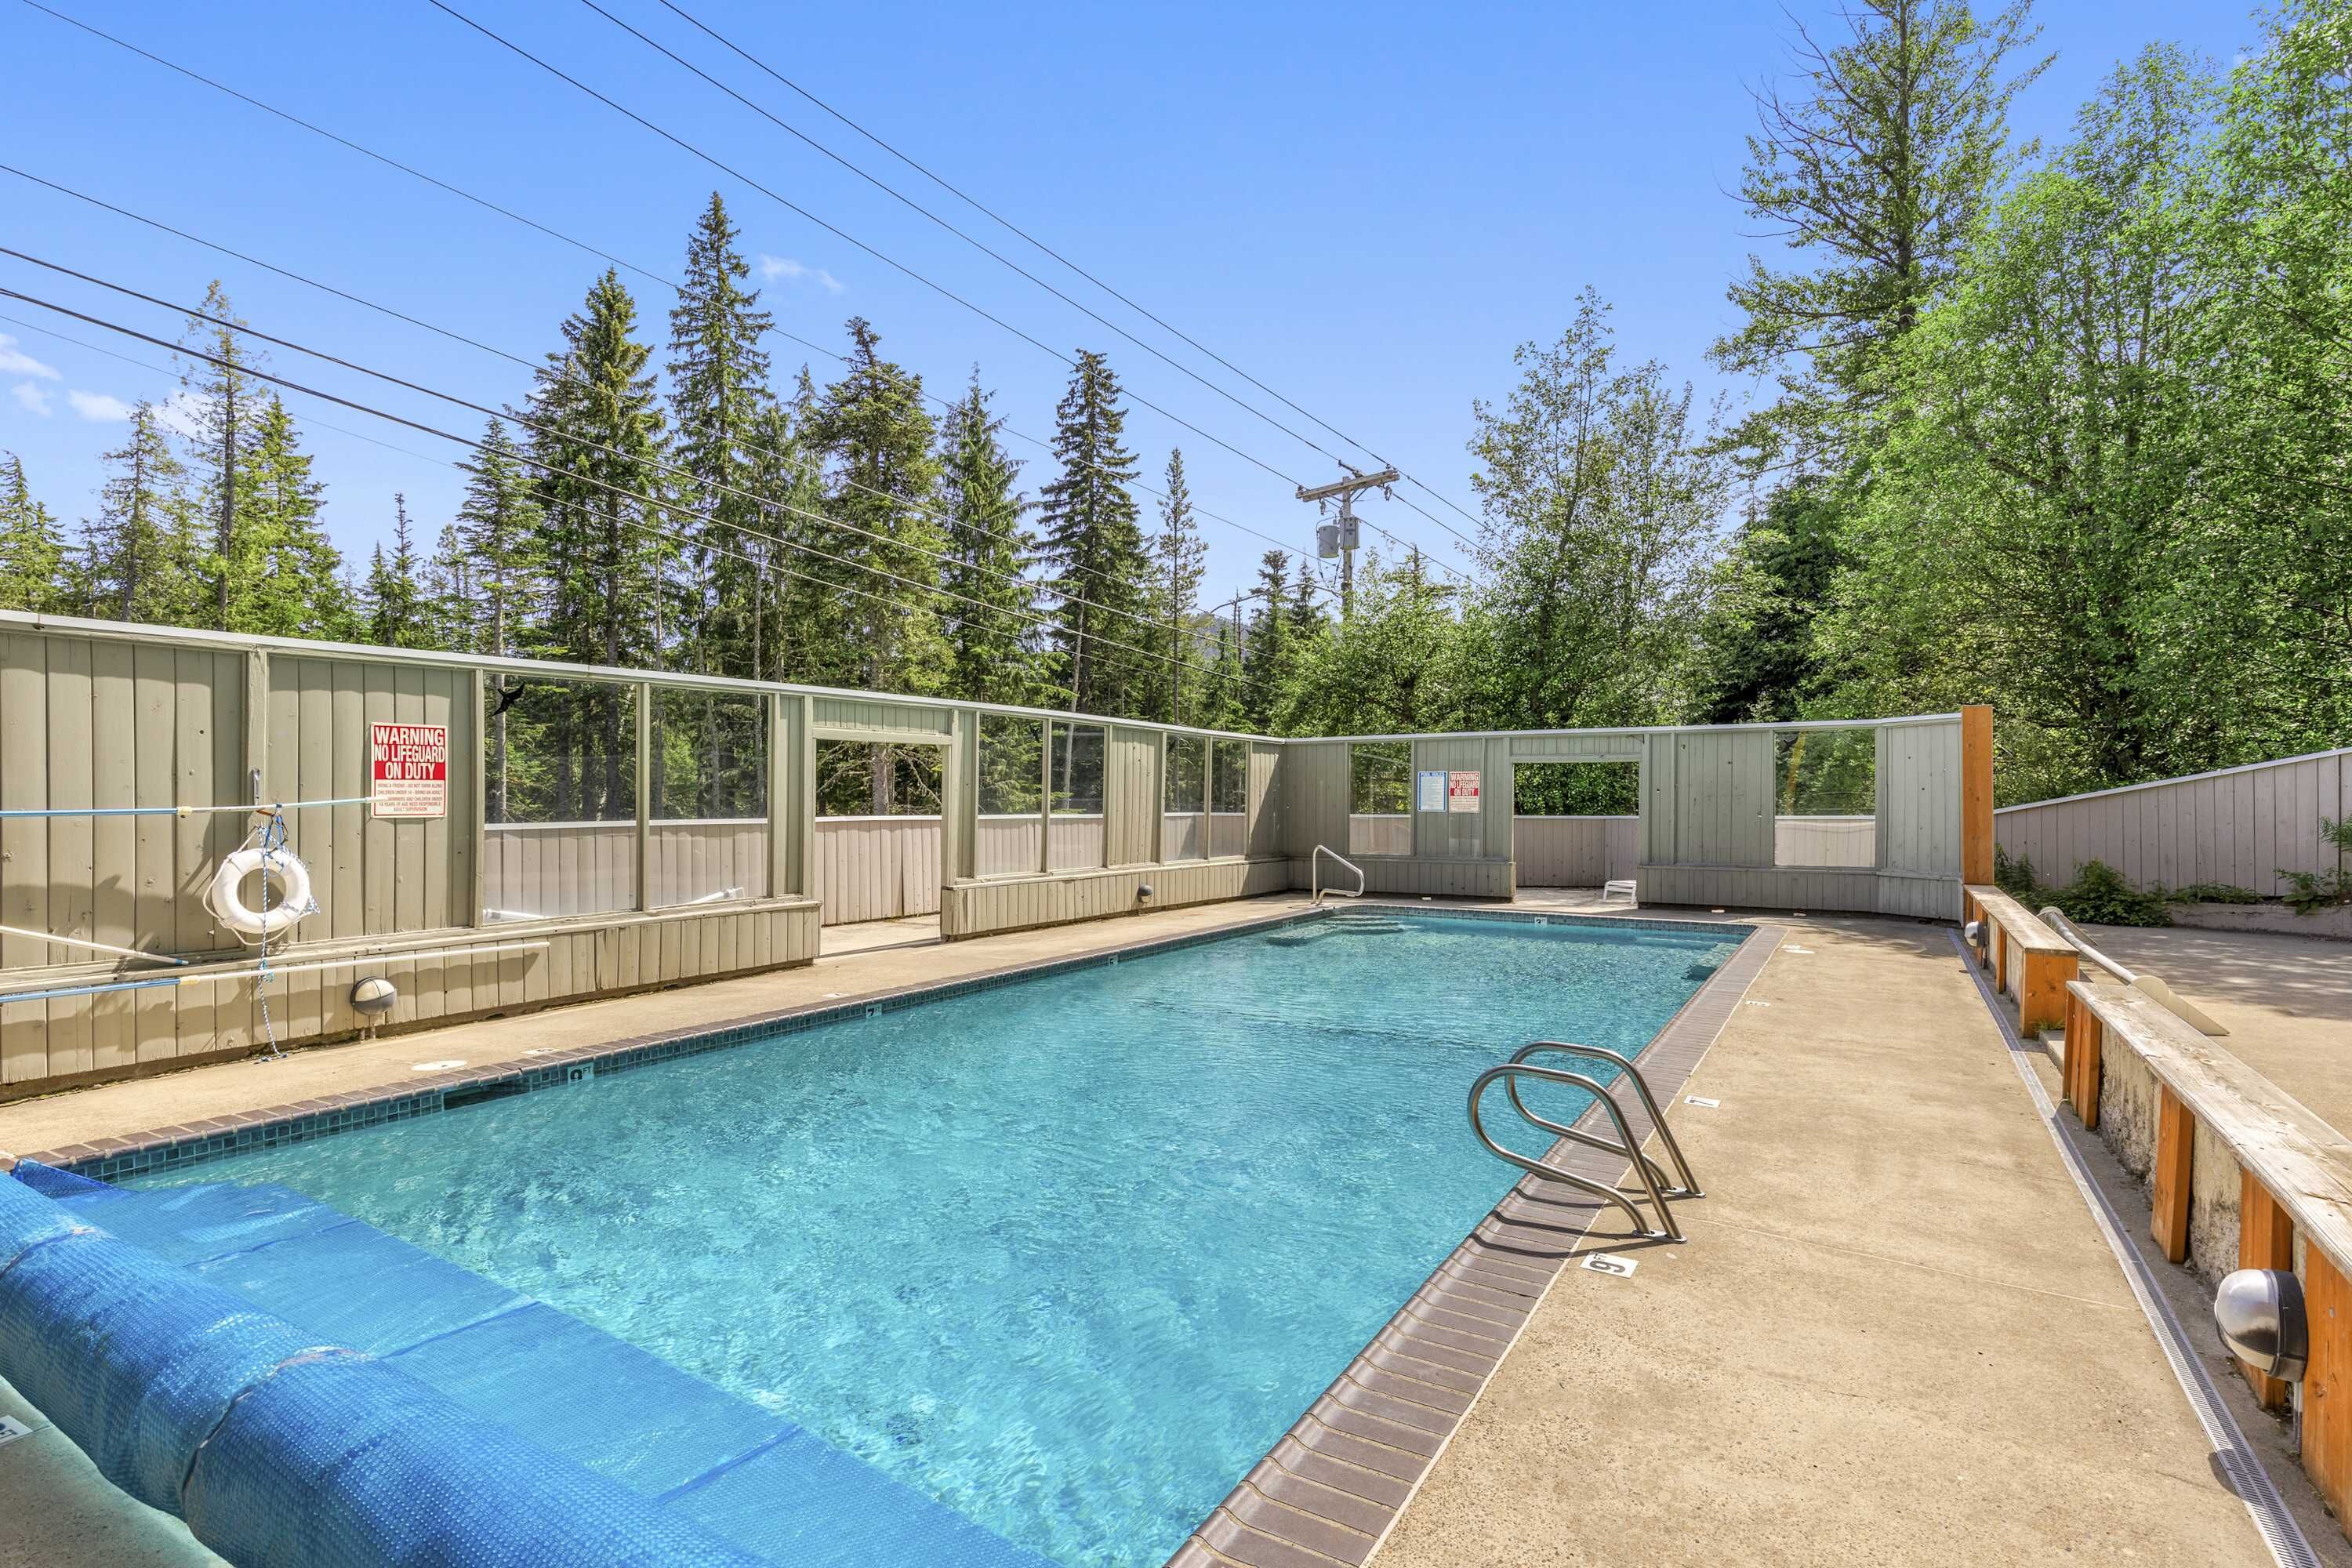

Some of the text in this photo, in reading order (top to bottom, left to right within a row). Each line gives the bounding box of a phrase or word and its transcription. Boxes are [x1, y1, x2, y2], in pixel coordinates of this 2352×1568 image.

[375, 726, 445, 746] WARNING
[375, 744, 445, 763] NO LIFEGUARD
[385, 761, 436, 779] ON DUTY
[1450, 780, 1456, 789] NO
[1454, 788, 1475, 797] ON DUTY
